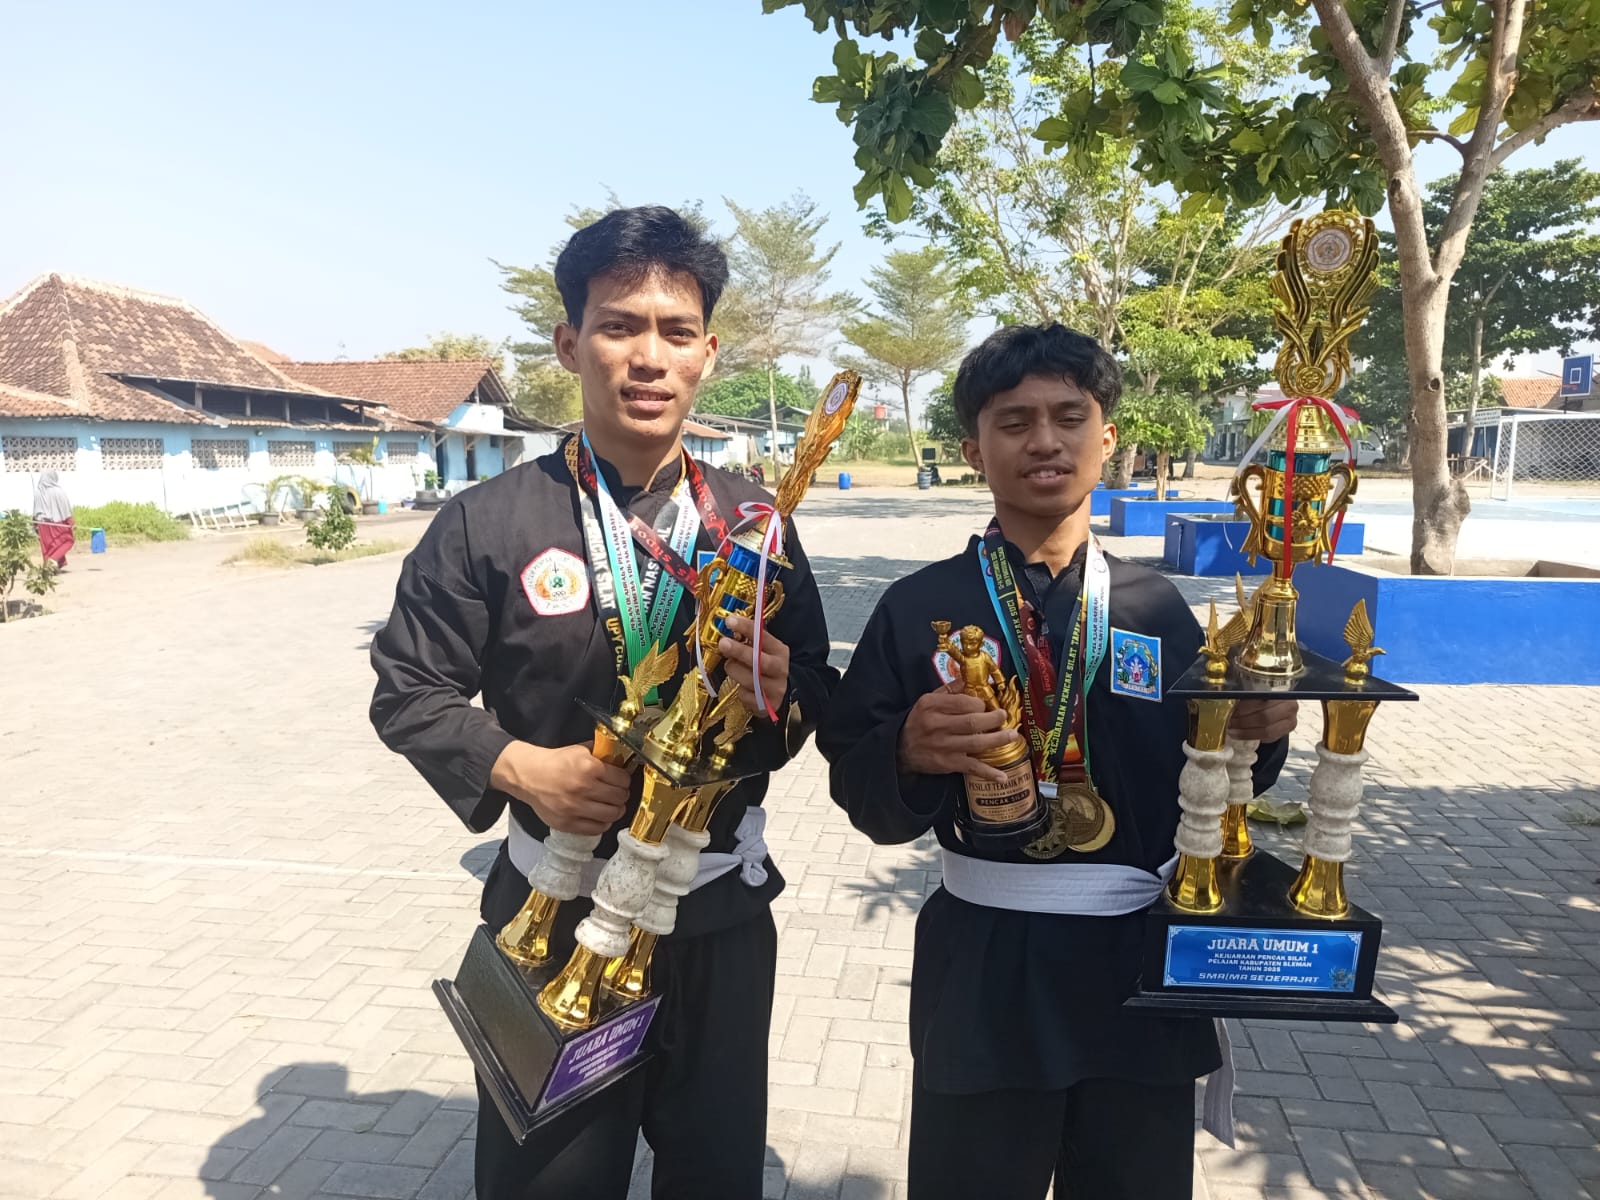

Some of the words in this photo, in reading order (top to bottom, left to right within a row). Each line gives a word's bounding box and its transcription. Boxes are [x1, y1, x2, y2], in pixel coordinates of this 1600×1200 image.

[596, 573, 616, 609] SILAT
[606, 616, 624, 644] UPY
[1006, 599, 1017, 617] SUCI
[1065, 647, 1077, 670] SILAT
[1058, 672, 1073, 703] PENCAK
[1047, 704, 1067, 754] KEJUARAAN
[1028, 727, 1042, 752] 2025
[1207, 938, 1259, 951] JUARA
[1263, 939, 1309, 953] UMUM
[1311, 944, 1319, 954] 1
[1208, 958, 1239, 966] PELAJAR
[1214, 953, 1256, 961] KEJUARAAN
[1257, 954, 1286, 962] PENCAK
[1249, 974, 1320, 984] SEDERAJAT
